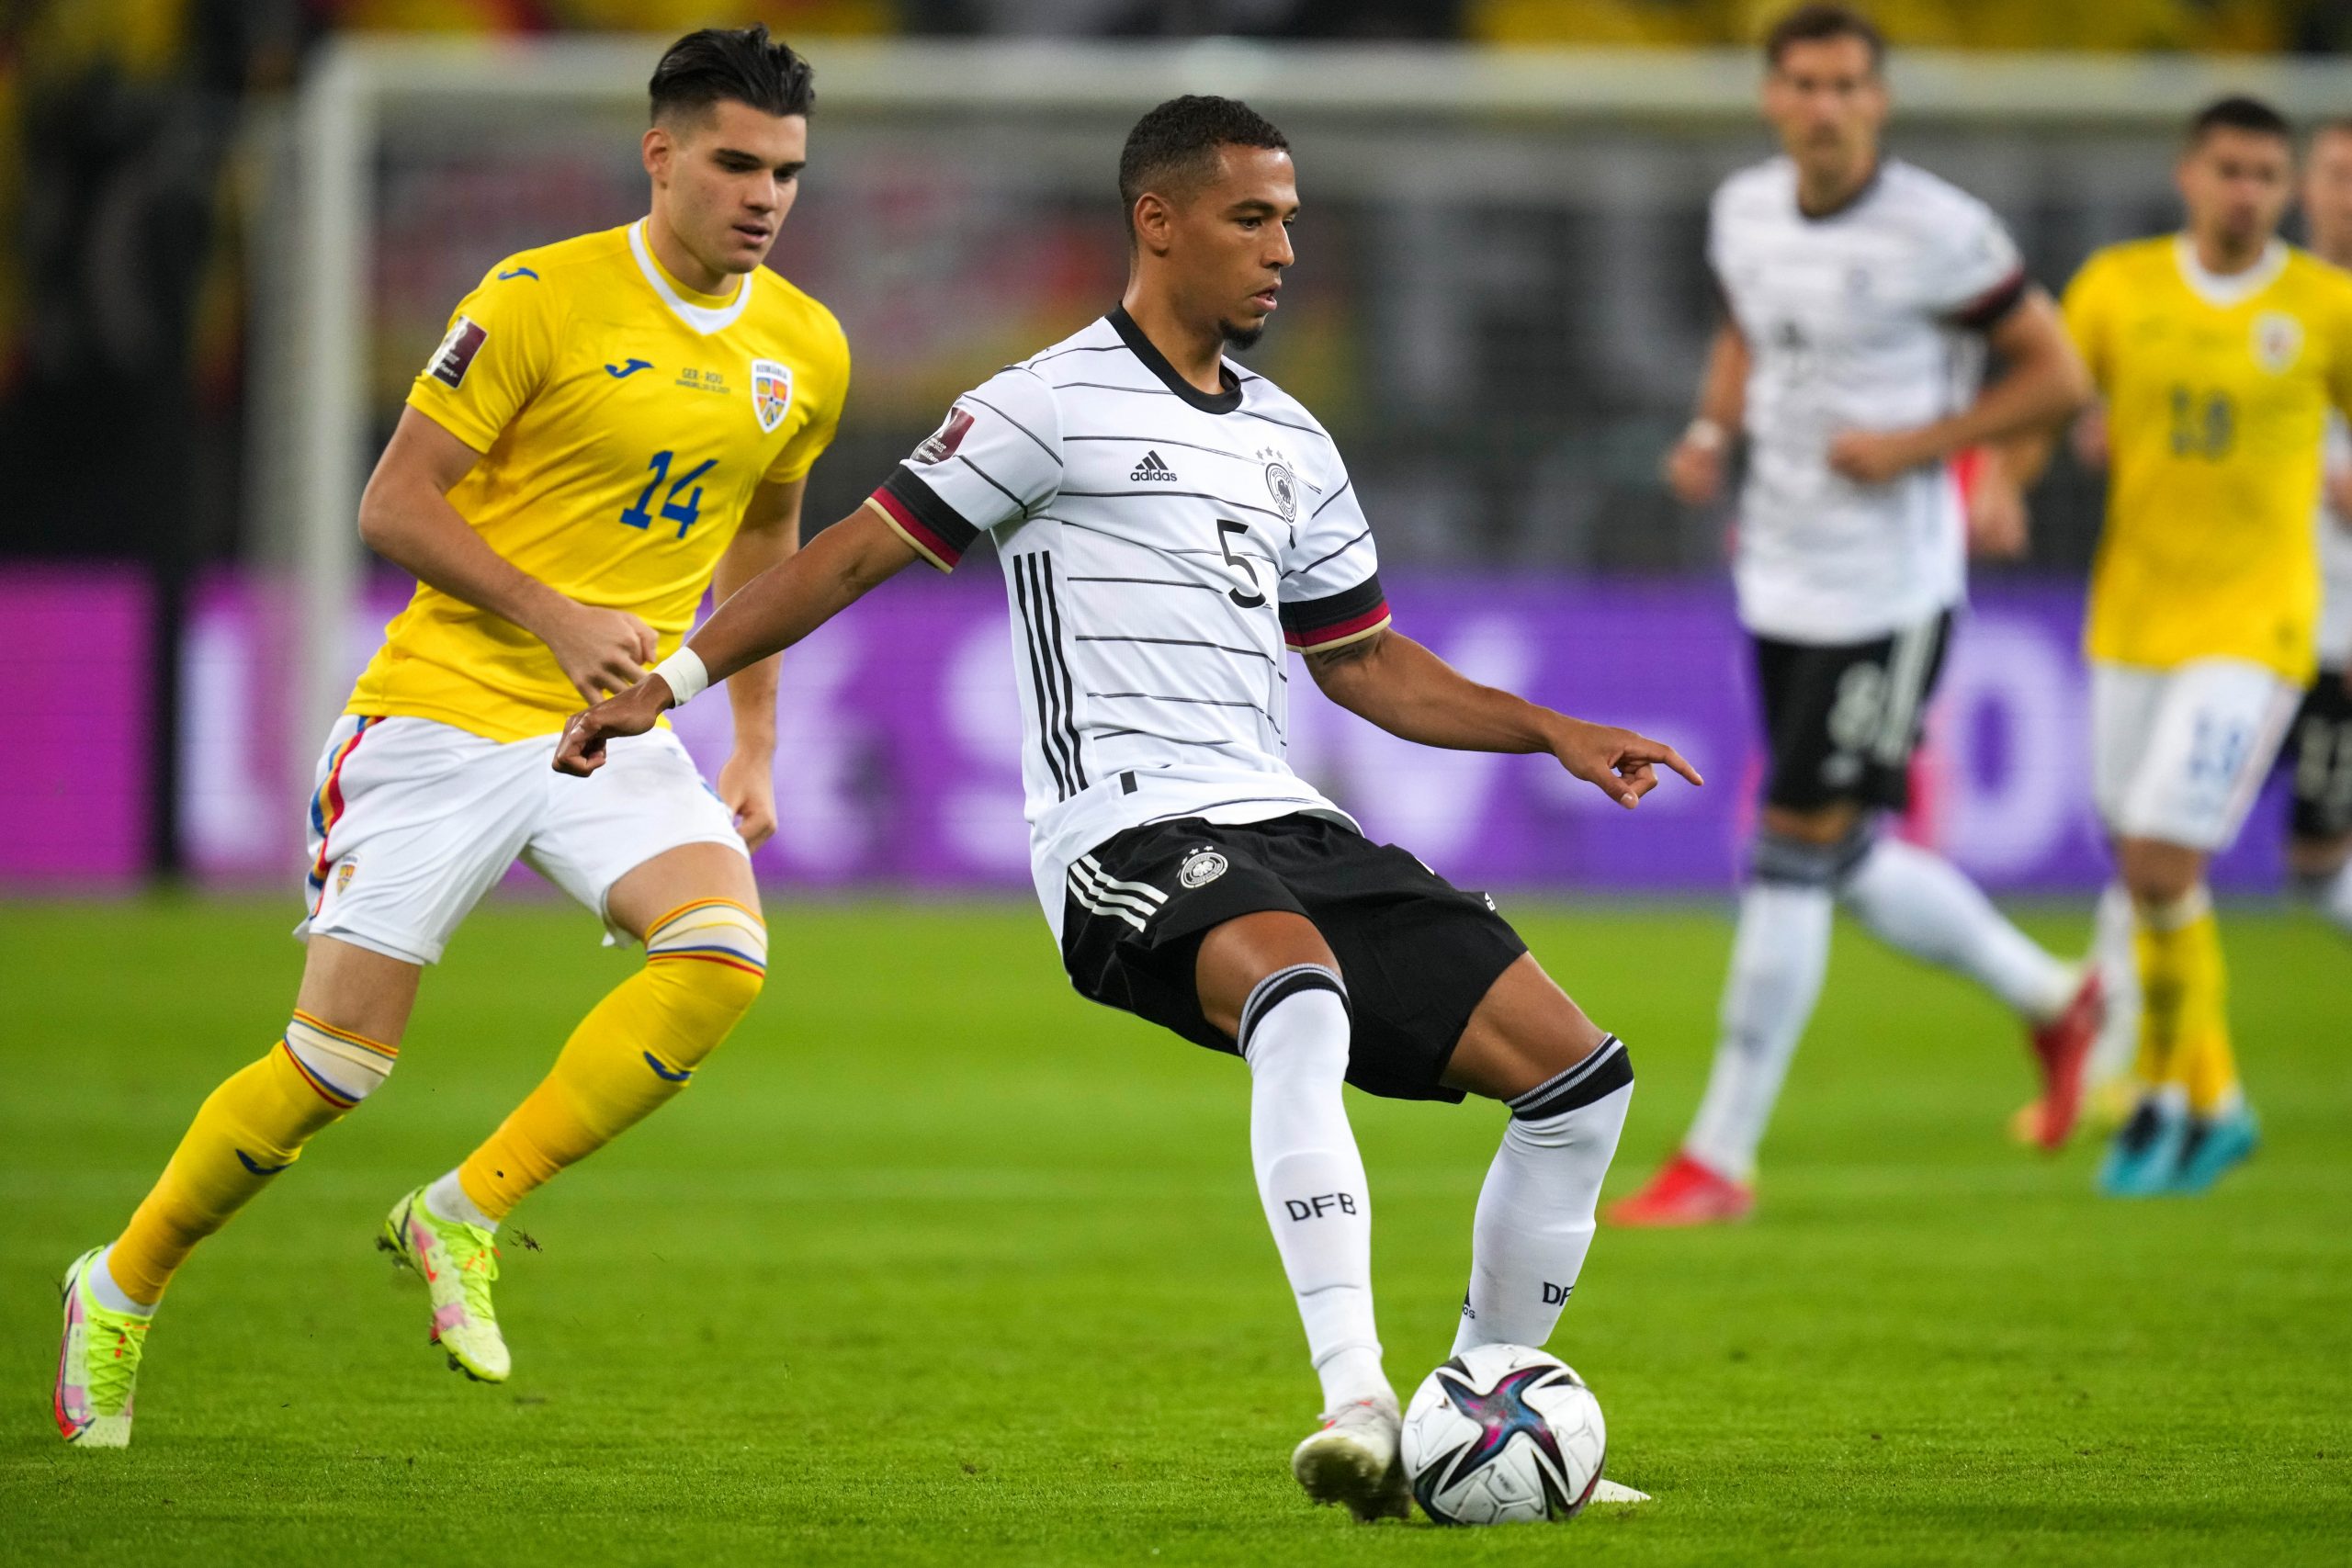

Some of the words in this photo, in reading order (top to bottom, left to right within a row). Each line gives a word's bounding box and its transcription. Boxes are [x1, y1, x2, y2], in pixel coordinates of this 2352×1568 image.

[1130, 468, 1177, 481] adidas
[619, 449, 719, 540] 14
[1216, 518, 1266, 609] 5
[1284, 1192, 1356, 1222] DFB
[1542, 1281, 1574, 1306] DF
